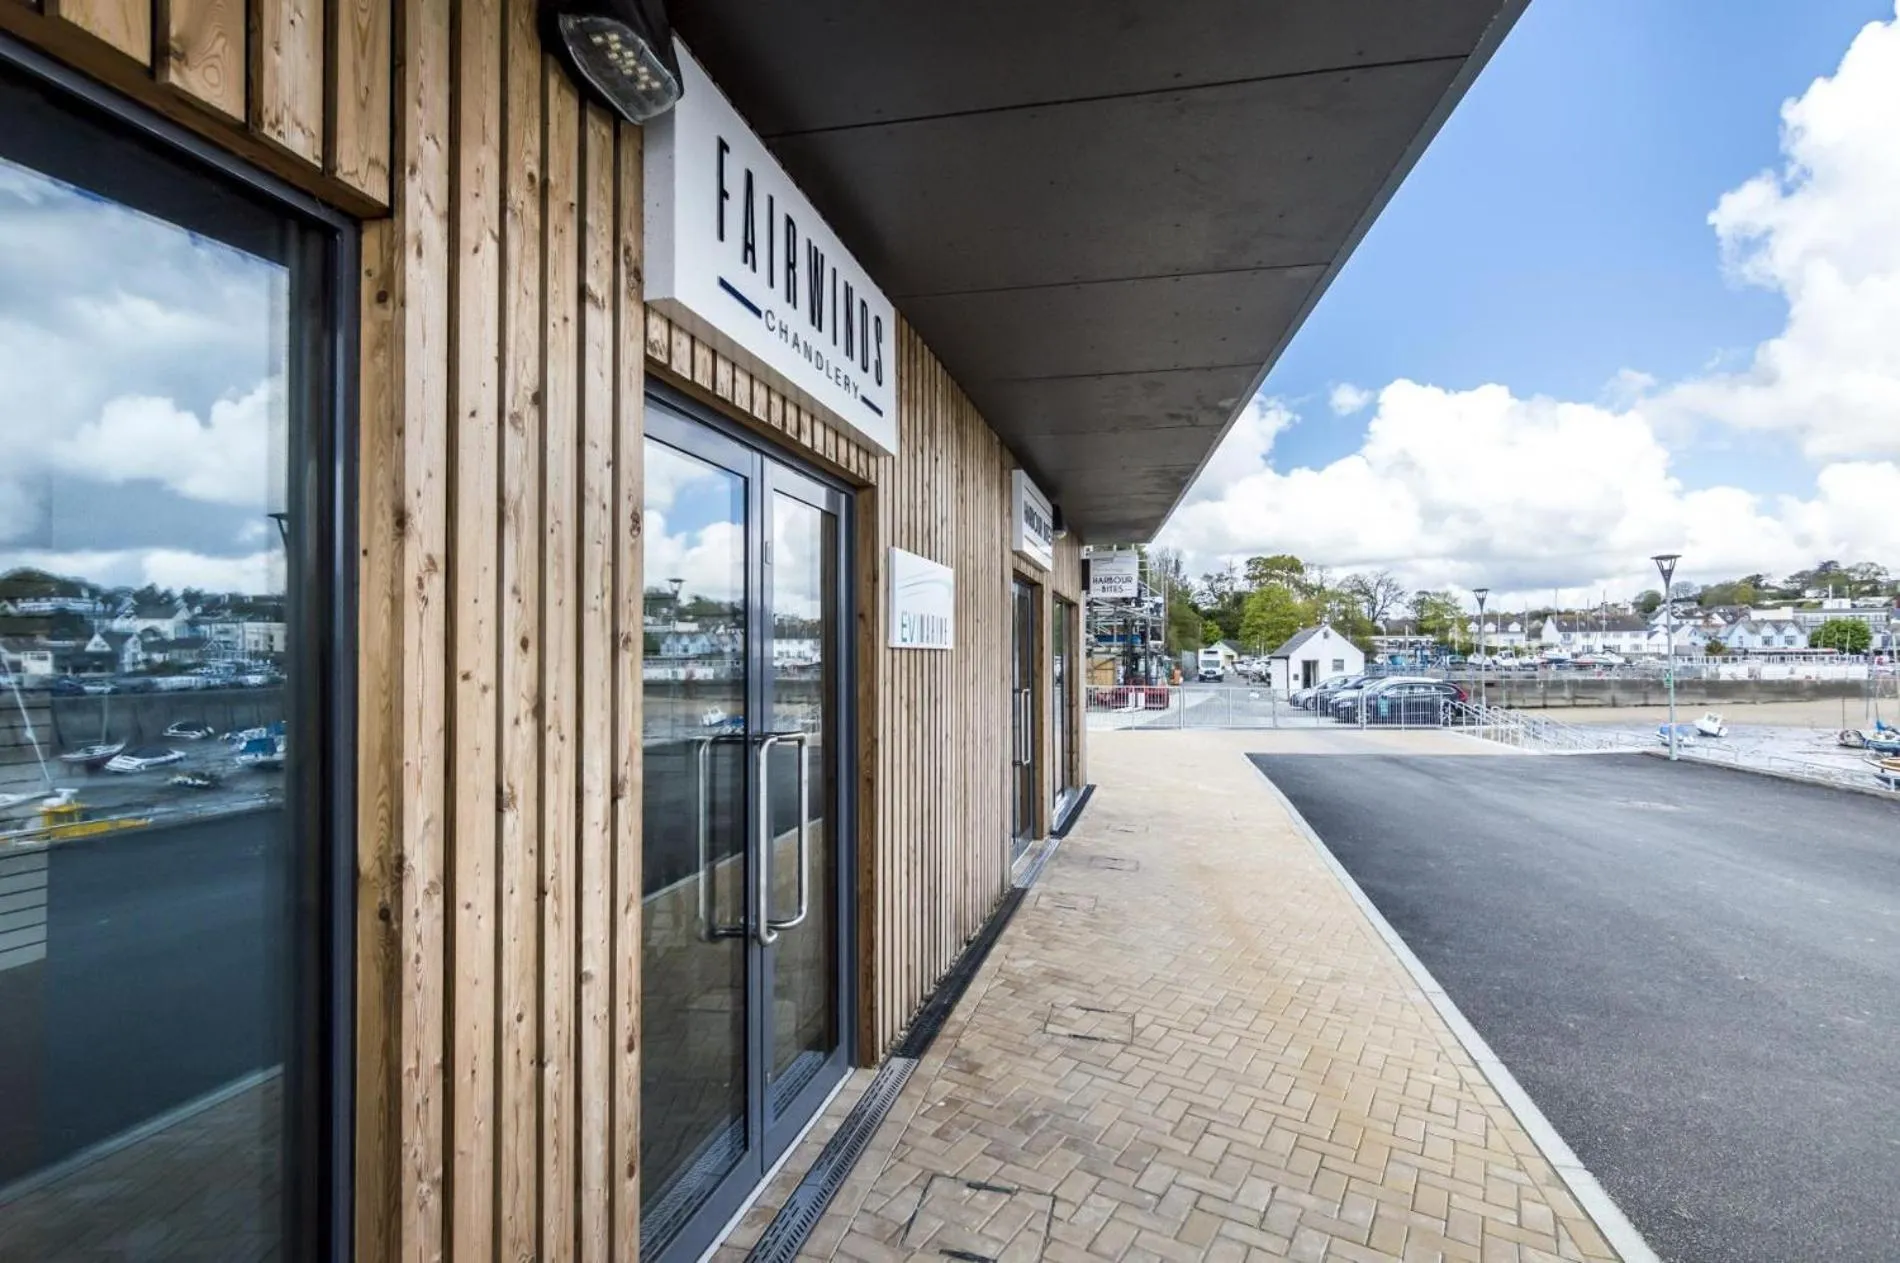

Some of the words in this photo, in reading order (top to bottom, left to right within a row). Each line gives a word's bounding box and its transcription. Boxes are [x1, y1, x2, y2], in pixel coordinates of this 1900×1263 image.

[717, 135, 883, 387] FAIRWINDS
[764, 308, 860, 400] CHANDLERY
[1092, 576, 1133, 584] HARBOUR
